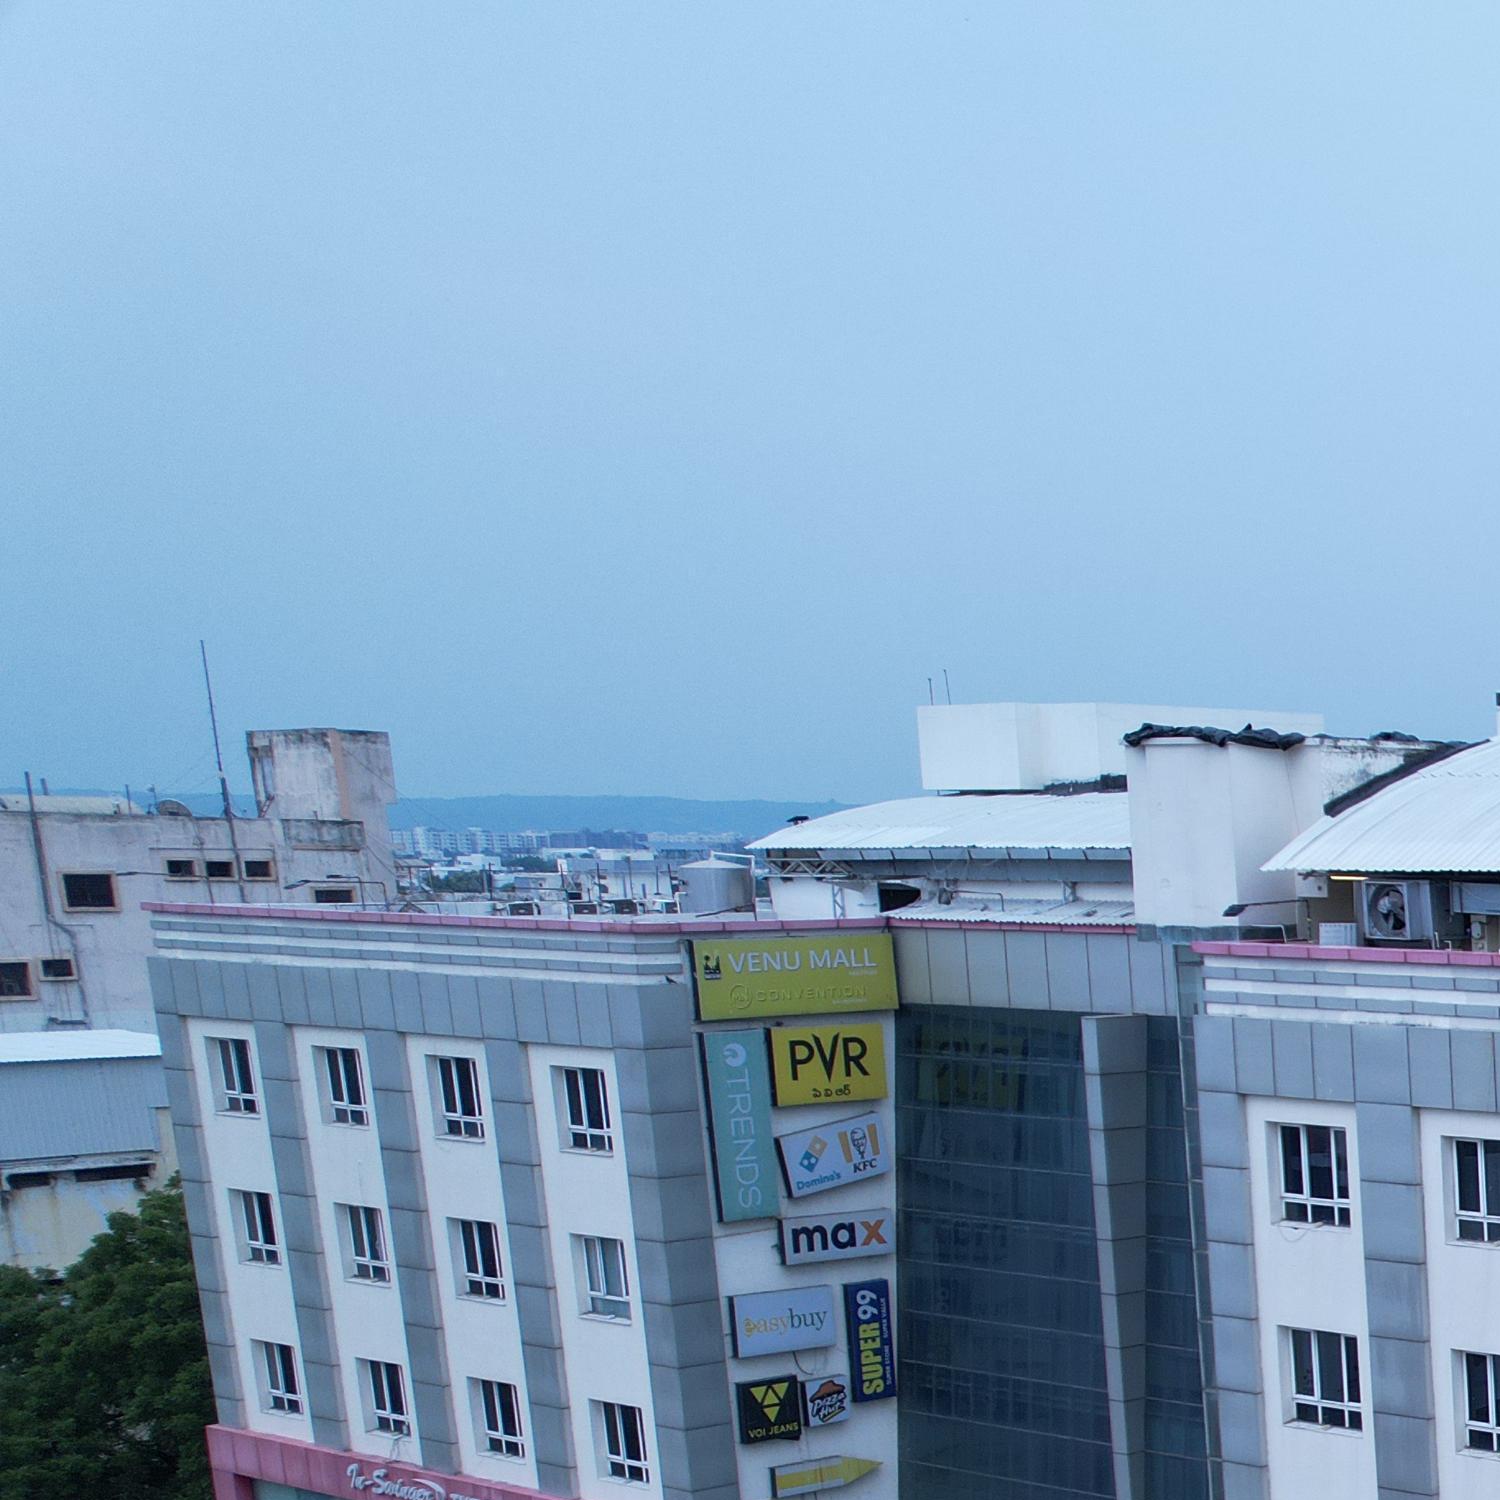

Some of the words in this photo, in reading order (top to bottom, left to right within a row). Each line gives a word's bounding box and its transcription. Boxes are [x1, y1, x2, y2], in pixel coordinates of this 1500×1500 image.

[727, 952, 801, 973] VENU
[809, 947, 877, 969] MALL
[788, 1031, 871, 1083] PVR
[725, 1071, 762, 1209] TRENDS
[853, 1157, 878, 1173] KFC
[796, 1170, 842, 1191] Domino's
[791, 1218, 888, 1254] max
[856, 1290, 880, 1321] 99
[859, 1322, 885, 1395] SUPER
[813, 1392, 848, 1418] Pizza
[818, 1404, 842, 1420] Hut
[748, 1428, 766, 1438] VOI
[769, 1422, 799, 1436] JEANS
